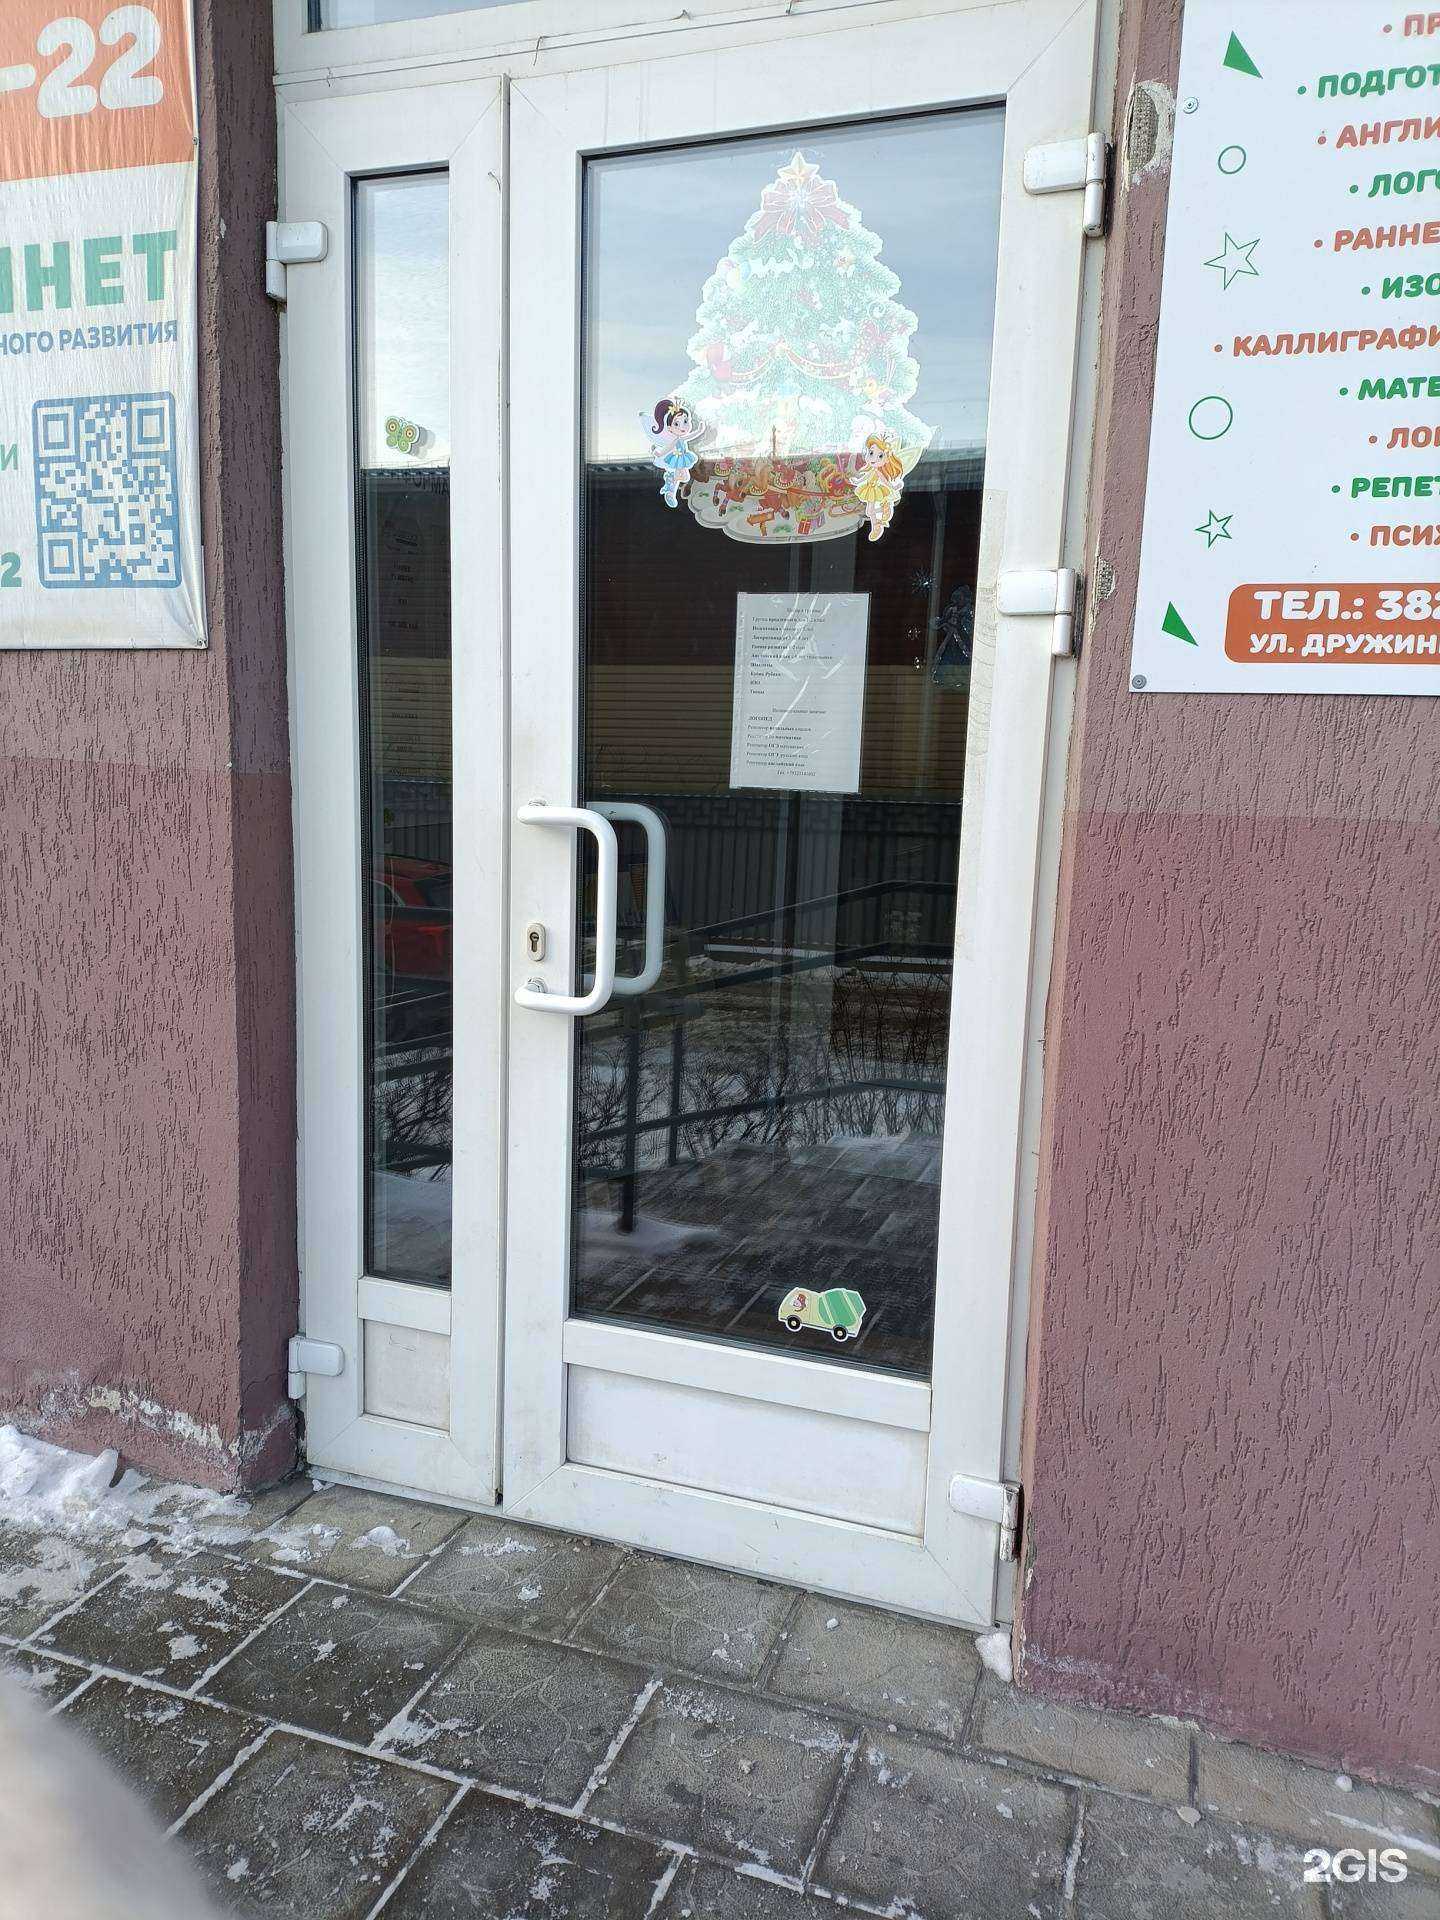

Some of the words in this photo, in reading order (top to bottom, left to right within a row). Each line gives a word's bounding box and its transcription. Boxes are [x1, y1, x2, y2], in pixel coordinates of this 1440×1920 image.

[1336, 116, 1440, 148] АНГЛИ
[1368, 168, 1440, 197] ЛОГ
[1334, 221, 1440, 251] РАННЕ
[1382, 273, 1440, 299] ИЗО
[59, 320, 177, 350] РАЗВИТИЯ
[1233, 325, 1440, 356] КАЛЛИГРАФИ
[1358, 376, 1440, 400] МАТЕ
[1254, 591, 1364, 620] ТЕЛ.:
[1249, 634, 1295, 655] УЛ.
[1302, 633, 1440, 657] ДРУЖИН
